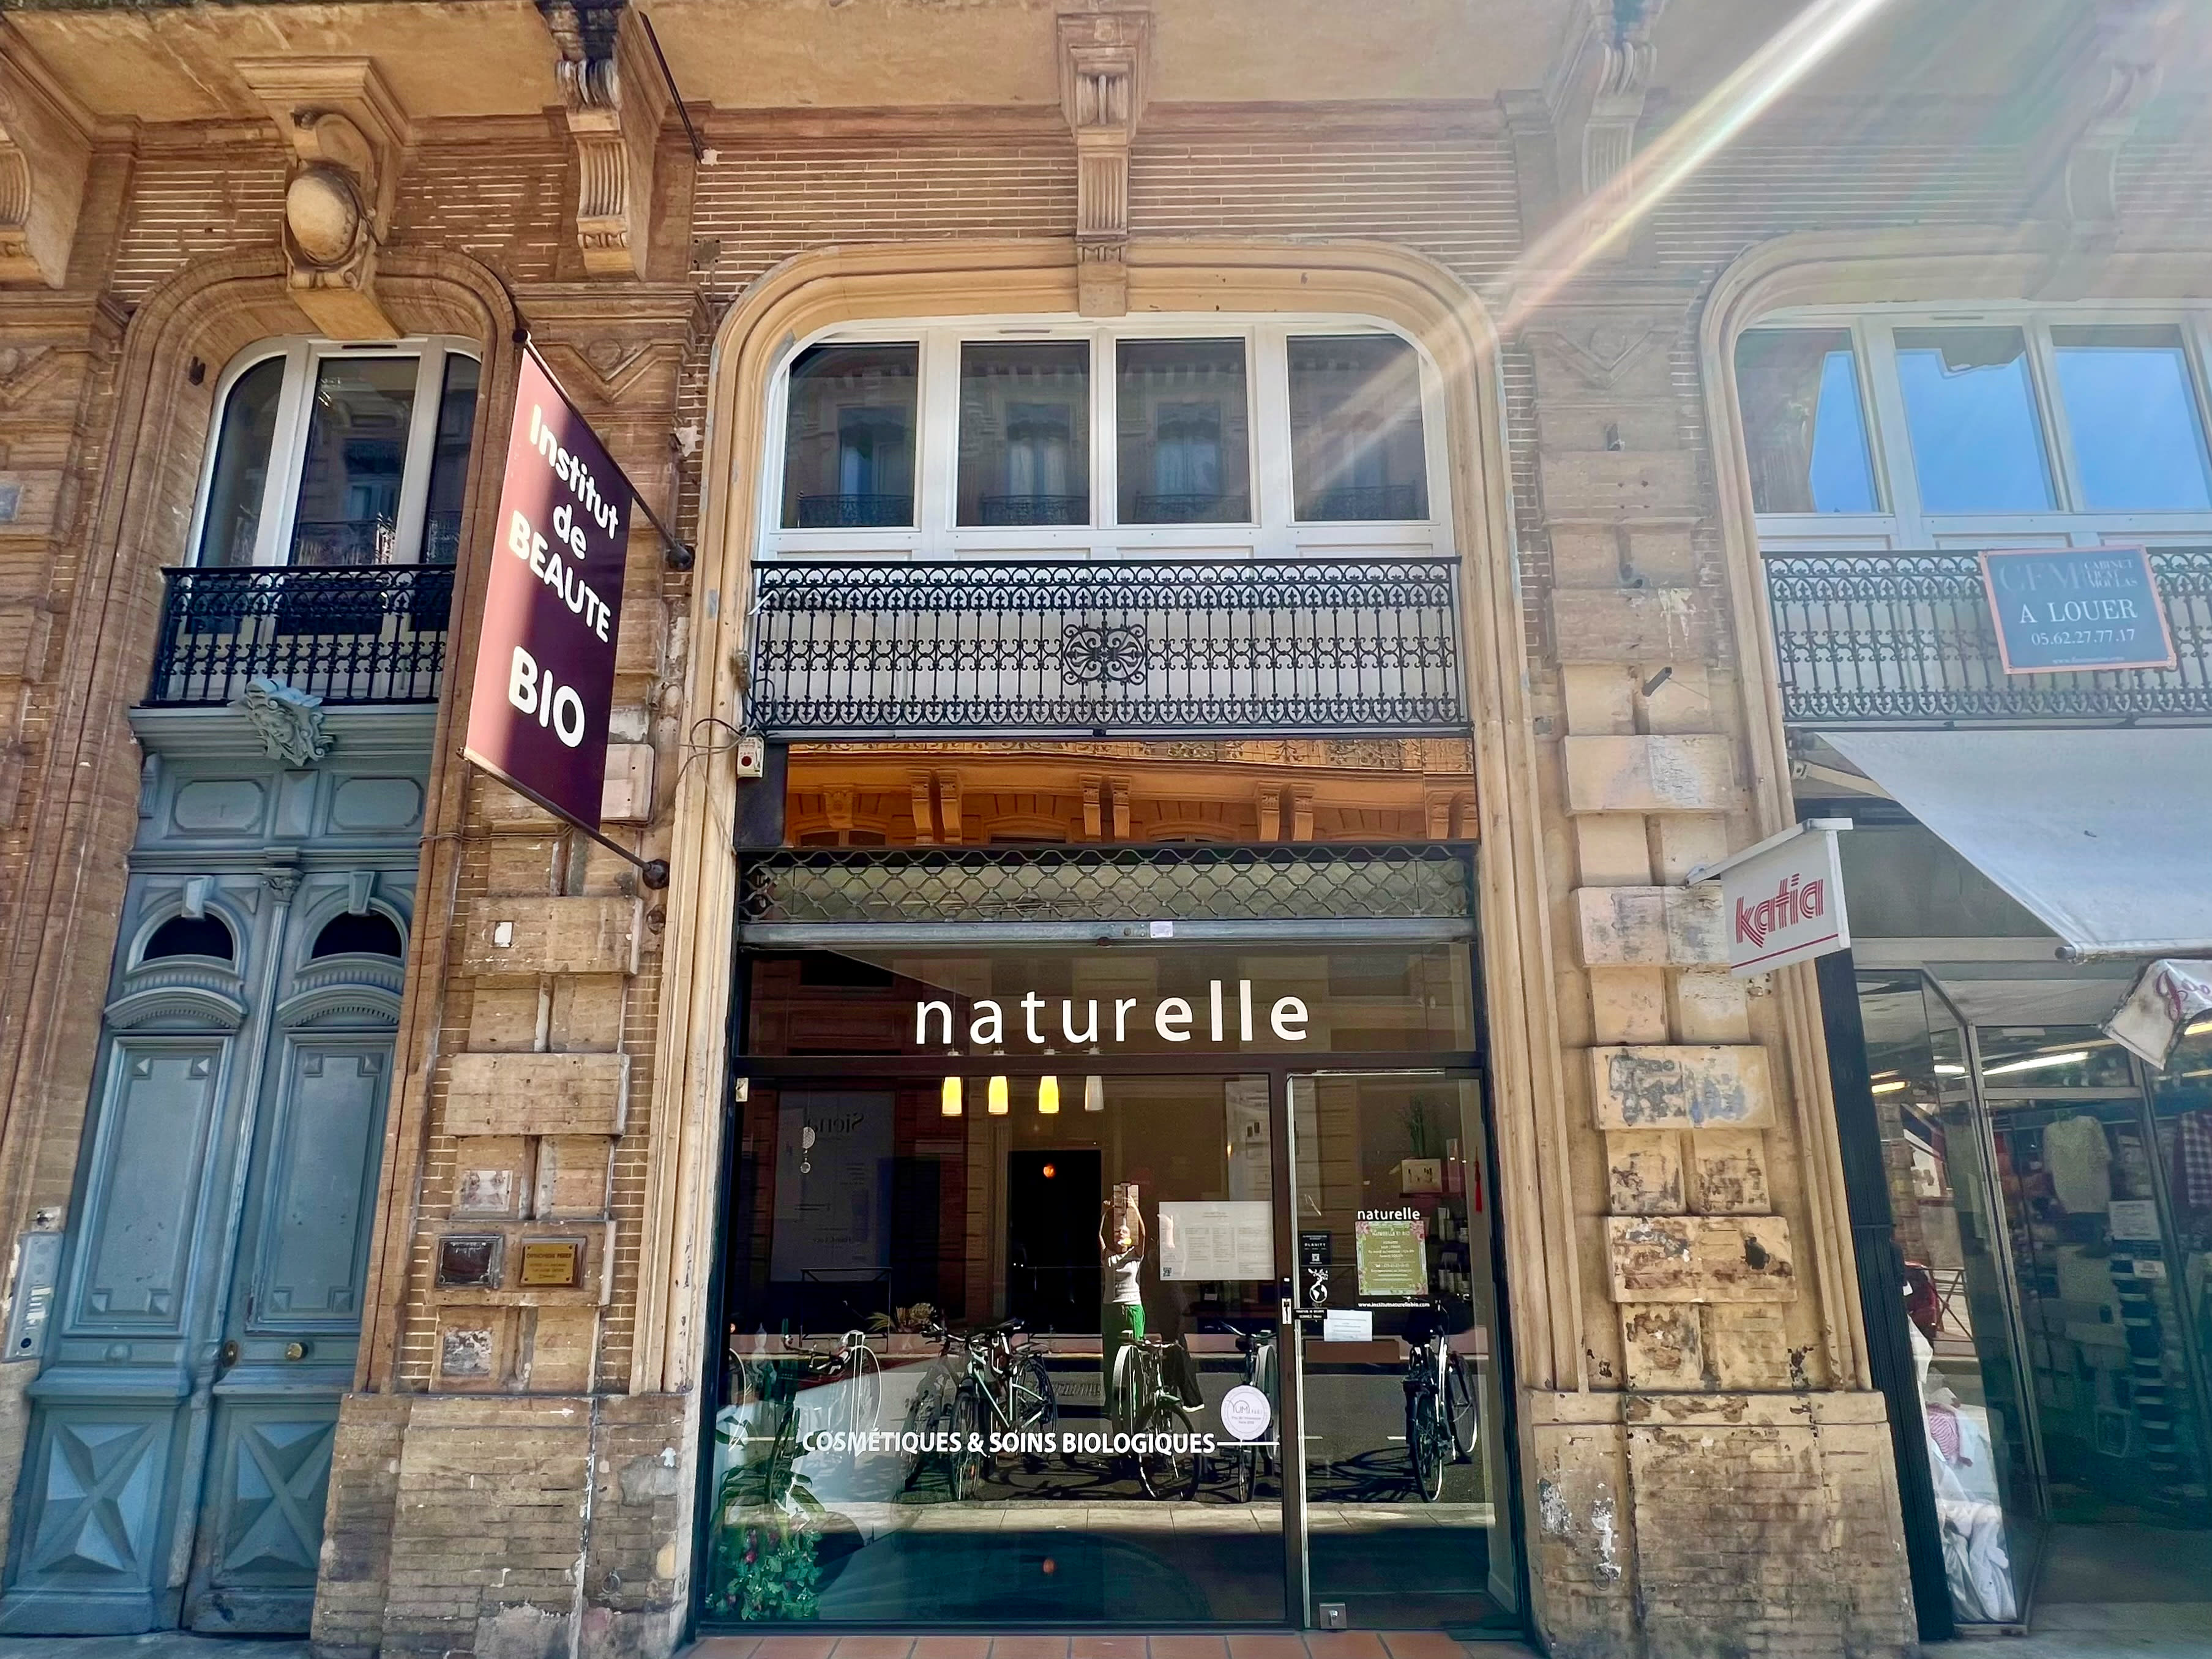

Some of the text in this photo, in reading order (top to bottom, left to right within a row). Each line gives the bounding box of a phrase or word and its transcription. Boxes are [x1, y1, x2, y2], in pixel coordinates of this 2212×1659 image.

[529, 403, 619, 541] Institut
[553, 504, 588, 560] de
[508, 509, 611, 643] BEAUTE
[2019, 598, 2138, 624] A LOUER
[2031, 628, 2135, 646] 05.62.27.77.17
[507, 645, 585, 748] BIO
[1735, 873, 1824, 948] katia
[916, 979, 1309, 1044] naturelle
[1357, 1207, 1421, 1220] naturelle
[802, 1427, 1216, 1455] COSMÉTIQUES & SOINS BIOLOGIQUES
